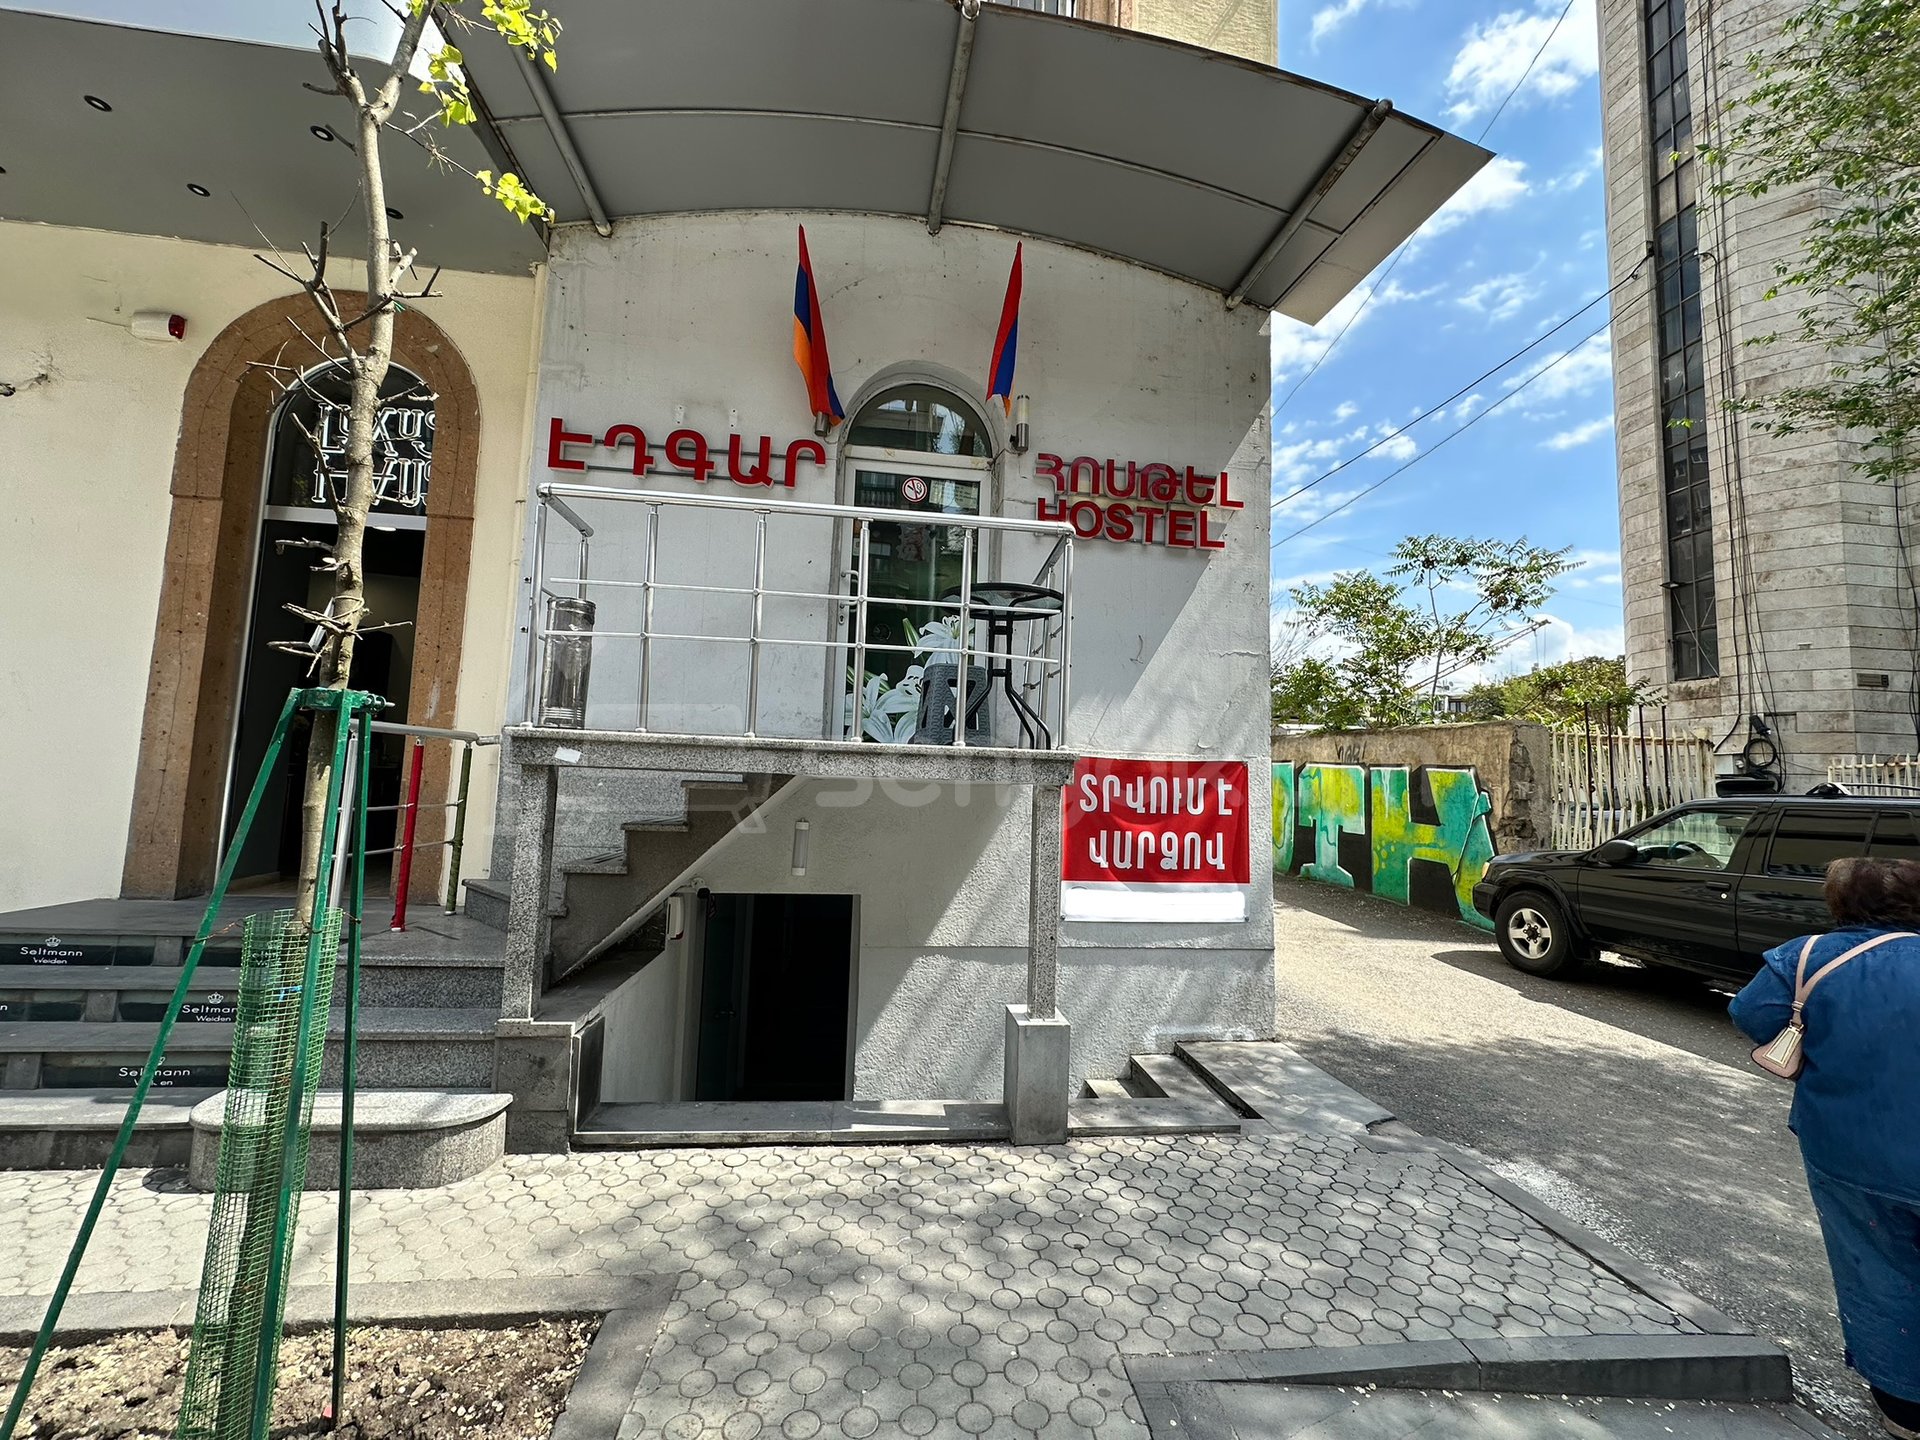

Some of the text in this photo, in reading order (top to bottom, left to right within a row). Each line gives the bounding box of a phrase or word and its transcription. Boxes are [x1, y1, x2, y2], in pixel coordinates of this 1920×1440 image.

[548, 417, 827, 489] ԷԴԳԱՐ
[1034, 452, 1245, 511] ՀՈՍԹԵԼ
[1035, 497, 1226, 549] HOSTEL
[1079, 773, 1234, 816] ՏՐՎՈՒՄ Է
[1088, 829, 1226, 871] ՎԱՐՁՈՎ
[20, 946, 83, 957] Seltmann
[33, 957, 68, 965] Weiden
[118, 1066, 191, 1077] Selmann
